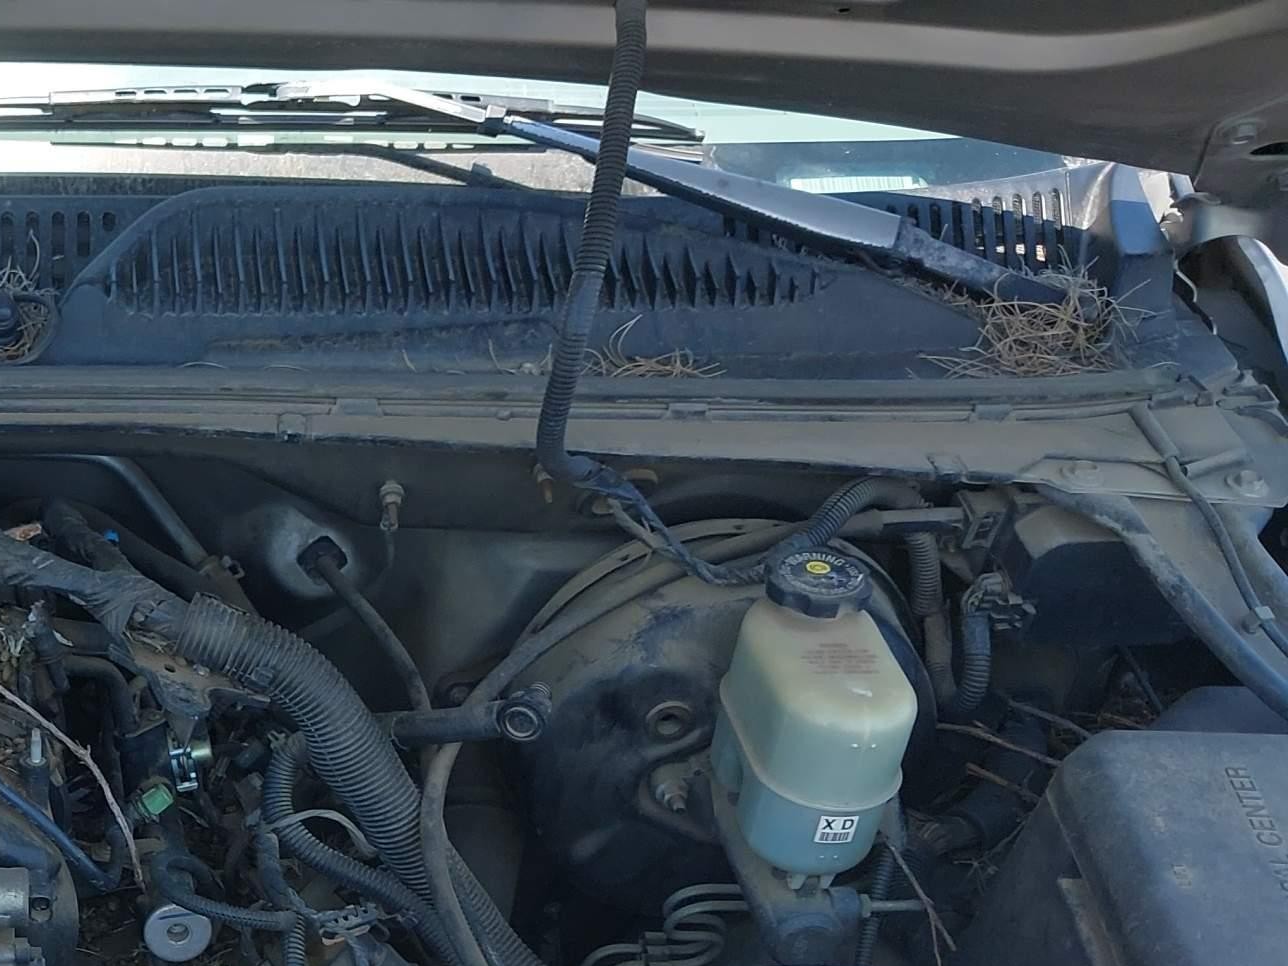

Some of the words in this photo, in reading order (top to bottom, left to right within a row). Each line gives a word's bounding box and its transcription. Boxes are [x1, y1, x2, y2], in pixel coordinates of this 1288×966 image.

[784, 552, 846, 566] WARNING
[1224, 766, 1283, 848] CENTER
[823, 819, 837, 830] X
[842, 819, 854, 830] D
